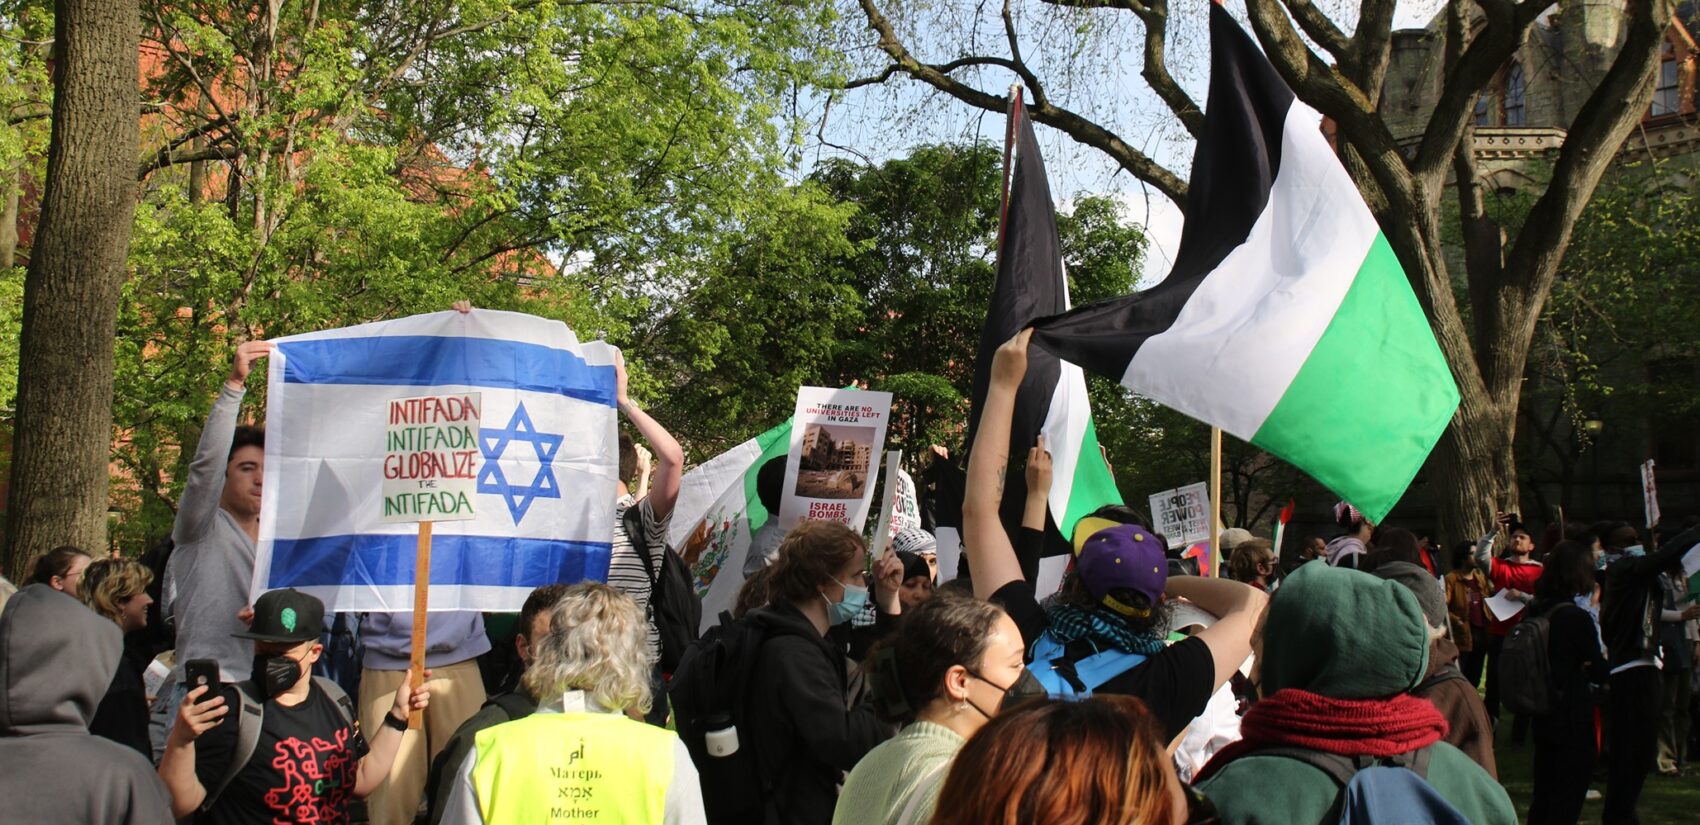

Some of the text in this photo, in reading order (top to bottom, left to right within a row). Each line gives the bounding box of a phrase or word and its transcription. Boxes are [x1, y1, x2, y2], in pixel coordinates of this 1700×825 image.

[390, 396, 480, 425] INTIFADA
[817, 403, 842, 411] THERE
[806, 408, 880, 419] UNIVERSITIES LEFT
[387, 425, 477, 452] INTIFADA
[384, 450, 478, 479] GLOBALIZE
[418, 480, 437, 489] THE
[385, 491, 474, 517] INTIFADA
[810, 502, 847, 511] ISRAEL
[808, 510, 846, 519] BOMBS
[550, 807, 600, 819] Mother
